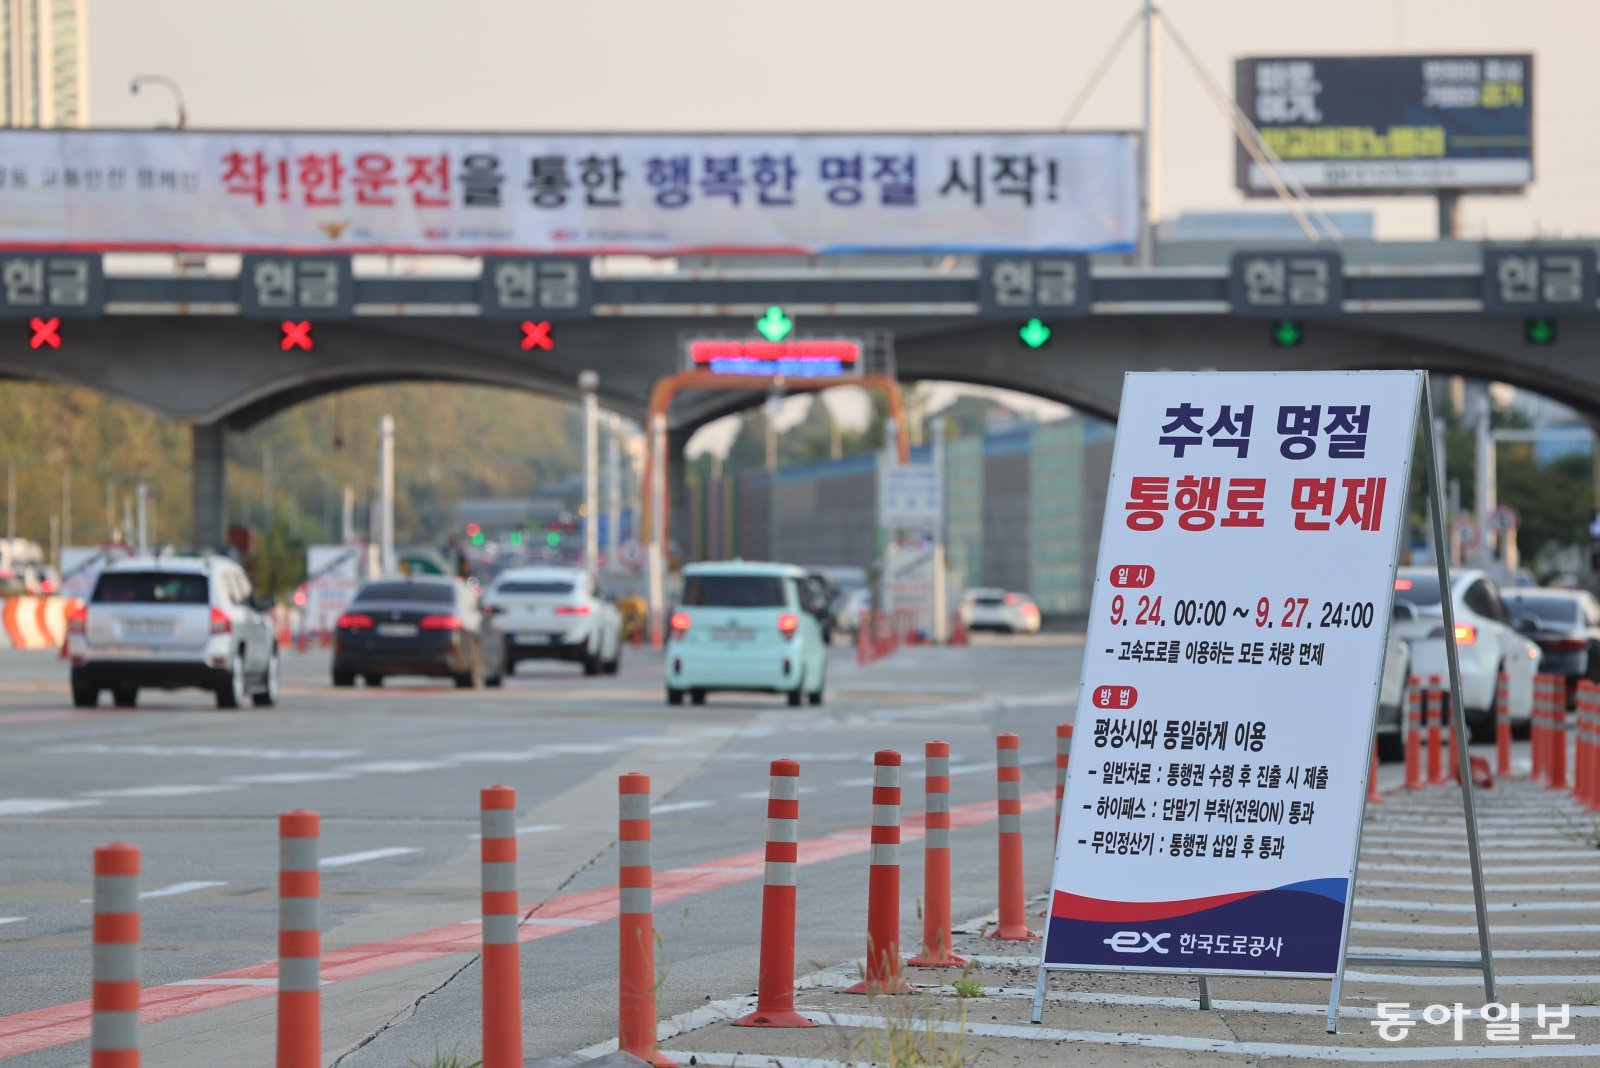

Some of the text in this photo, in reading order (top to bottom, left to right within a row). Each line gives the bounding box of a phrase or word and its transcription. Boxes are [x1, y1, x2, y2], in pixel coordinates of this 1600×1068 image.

[221, 150, 1060, 209] 착!한운전을 통한 행복한 명절 시작!
[1158, 402, 1371, 461] 추석 명절
[1125, 474, 1387, 532] 통행료 면제
[1173, 599, 1227, 627] 00:00
[1319, 601, 1374, 629] 24:00
[1117, 639, 1181, 664] 고속도로를
[1185, 640, 1235, 665] 이용하는
[1237, 641, 1265, 665] 모든
[1267, 641, 1295, 666] 차량
[1299, 642, 1325, 667] 면제
[1093, 717, 1267, 753] 평상시와 동일하게 이용
[1102, 761, 1152, 786] 일반차로
[1166, 763, 1206, 787] 통행권
[1208, 763, 1235, 788] 수령
[1237, 764, 1252, 789] 후
[1256, 764, 1282, 789] 진출
[1285, 765, 1300, 790] 시
[1302, 765, 1329, 790] 제출
[1096, 795, 1146, 821] 하이패스
[1162, 797, 1201, 823] 단말기
[1203, 798, 1285, 826] 부착(전원ON)
[1288, 800, 1315, 825] 통과
[1091, 830, 1155, 856] 무인정산기
[1169, 833, 1208, 858] 통행권
[1212, 834, 1238, 859] 삽입
[1240, 834, 1255, 859] 후
[1258, 835, 1285, 860] 통과
[1103, 931, 1284, 957] ex 한국도로공사
